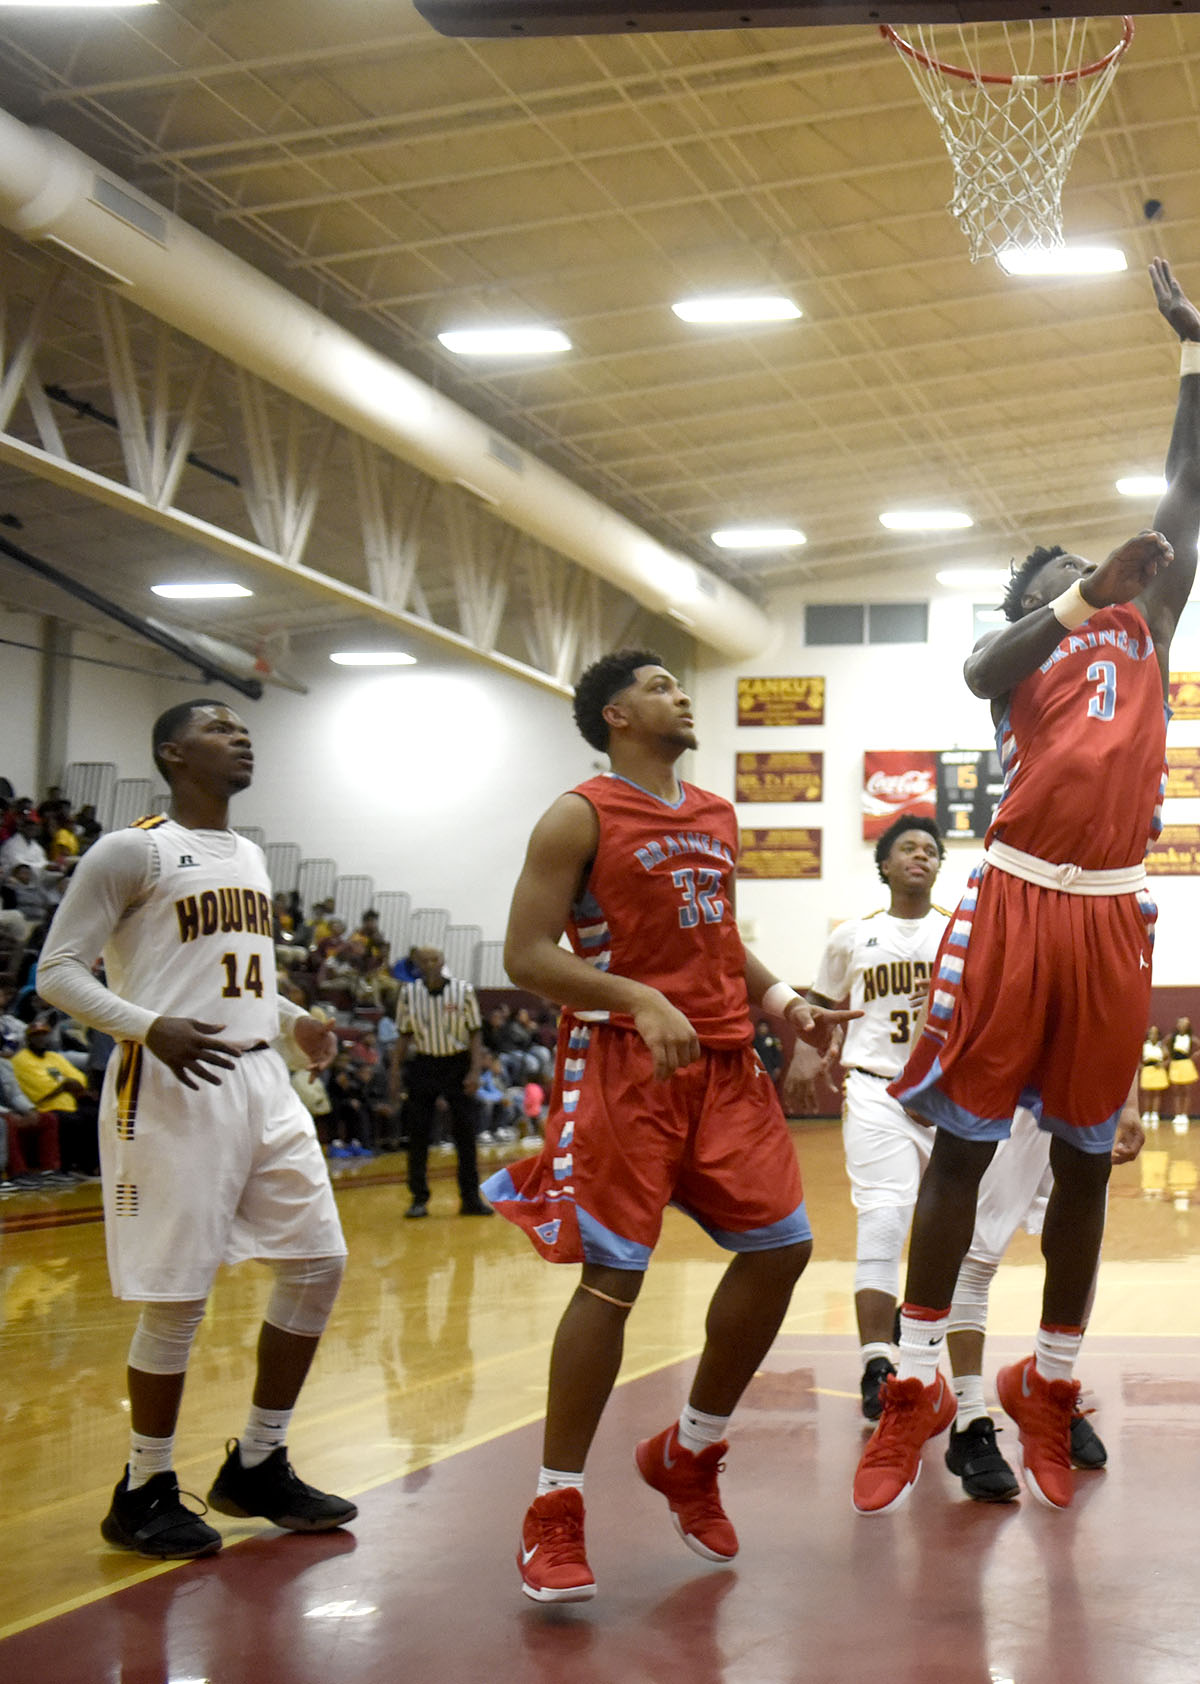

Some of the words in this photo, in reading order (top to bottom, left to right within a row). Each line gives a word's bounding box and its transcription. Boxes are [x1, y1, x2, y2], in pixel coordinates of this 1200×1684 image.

[1087, 660, 1116, 721] 3
[175, 887, 273, 943] HOWAR
[671, 868, 724, 928] 32
[221, 952, 264, 999] 14
[890, 1010, 921, 1044] 3
